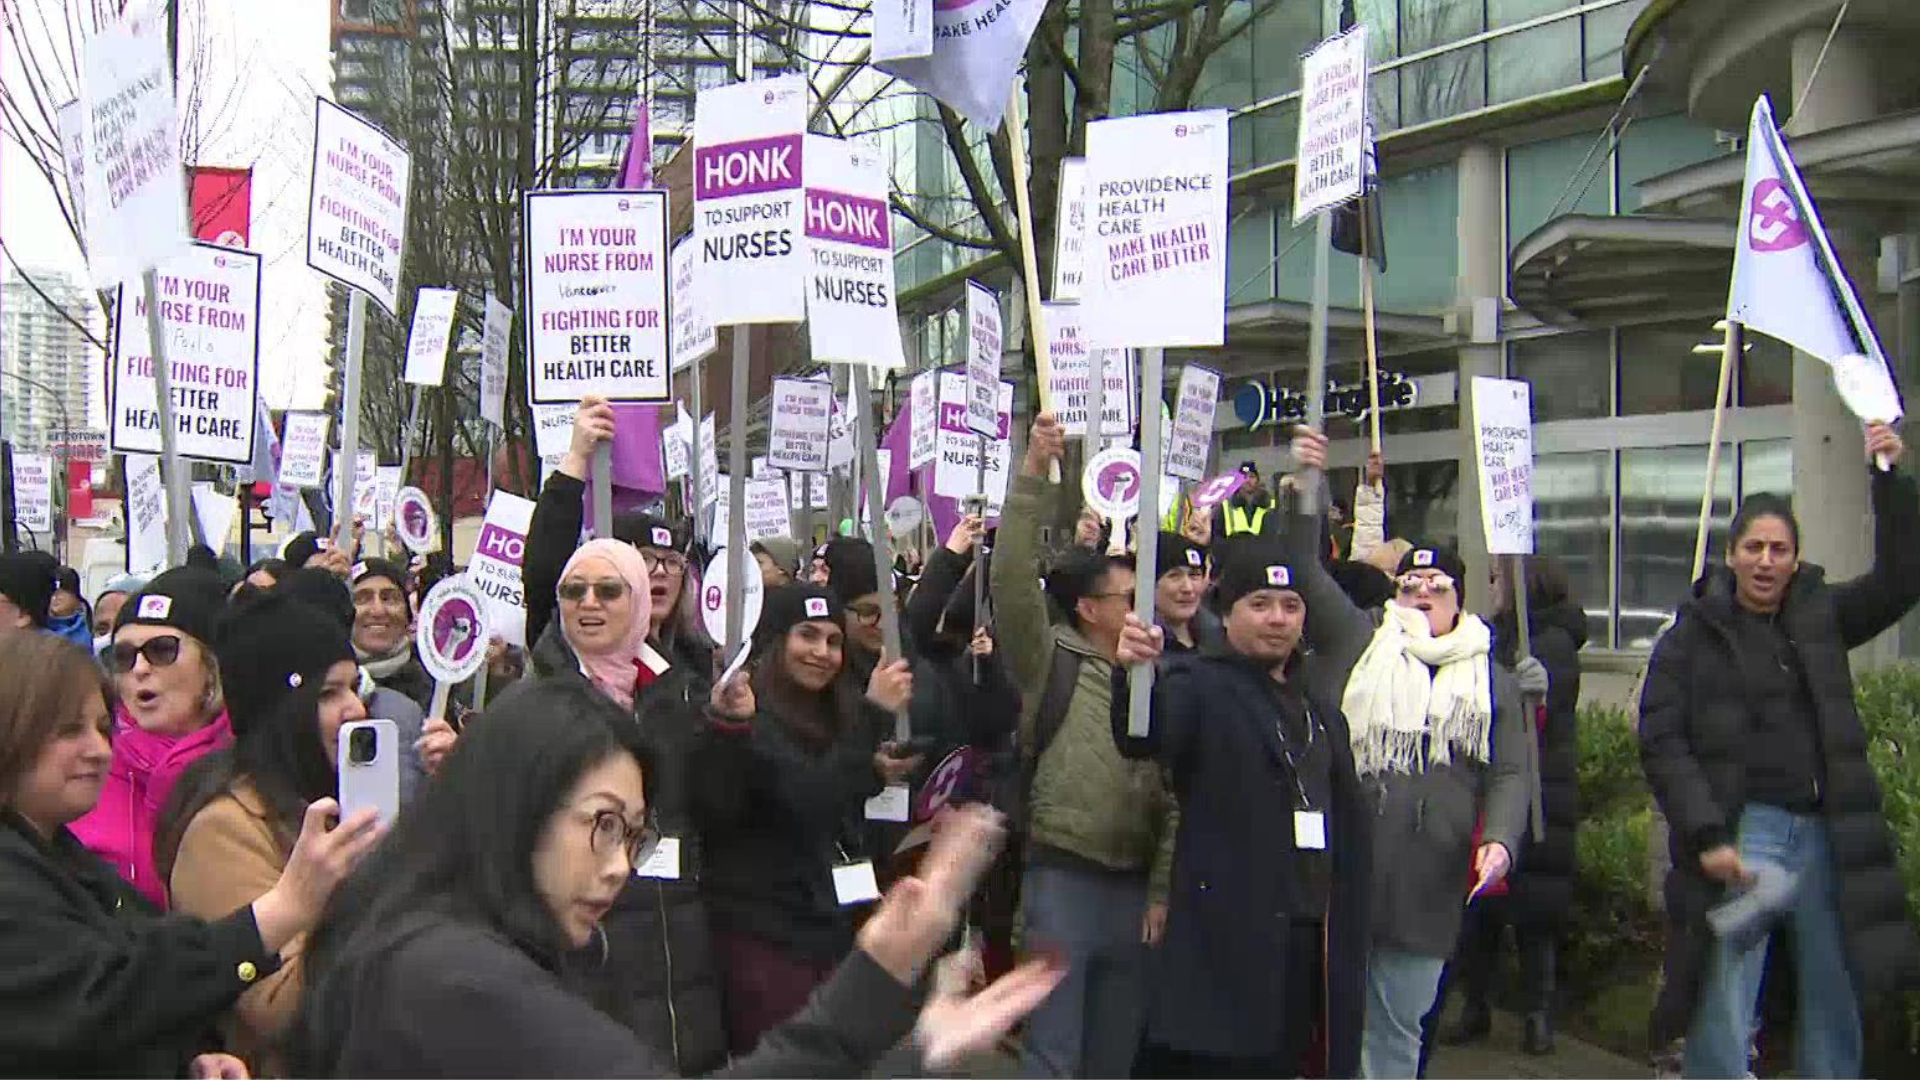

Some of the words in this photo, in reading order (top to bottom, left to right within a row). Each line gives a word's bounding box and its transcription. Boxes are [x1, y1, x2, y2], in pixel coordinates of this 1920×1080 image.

[704, 144, 792, 189] HONK
[1099, 174, 1212, 198] PROVIDENCE
[705, 208, 725, 227] TO
[726, 201, 792, 225] SUPPORT
[806, 197, 882, 239] HONK
[1098, 197, 1165, 218] HEALTH
[560, 228, 584, 246] I'M
[589, 228, 636, 246] YOUR
[1098, 219, 1142, 236] CARE
[318, 236, 368, 273] HEALTH
[340, 226, 385, 264] BETTER
[703, 228, 792, 264] NURSES
[1108, 236, 1147, 263] MAKE
[1150, 222, 1207, 250] HEALTH
[544, 253, 600, 273] NURSE
[605, 252, 654, 271] FROM
[813, 248, 828, 267] TO
[829, 250, 883, 274] SUPPORT
[1111, 258, 1148, 282] CARE
[1152, 243, 1210, 272] BETTER
[184, 278, 230, 303] YOUR
[815, 274, 887, 308] NURSES
[135, 296, 193, 323] NRSE
[199, 305, 246, 332] FROM
[541, 310, 621, 331] FIGHTING
[626, 310, 659, 329] FOR
[570, 335, 631, 355] BETTER
[127, 355, 210, 386] FIGTING
[215, 366, 248, 389] FOR
[544, 360, 605, 380] HEALTH
[170, 387, 219, 411] ETTER
[125, 407, 192, 434] HEAH
